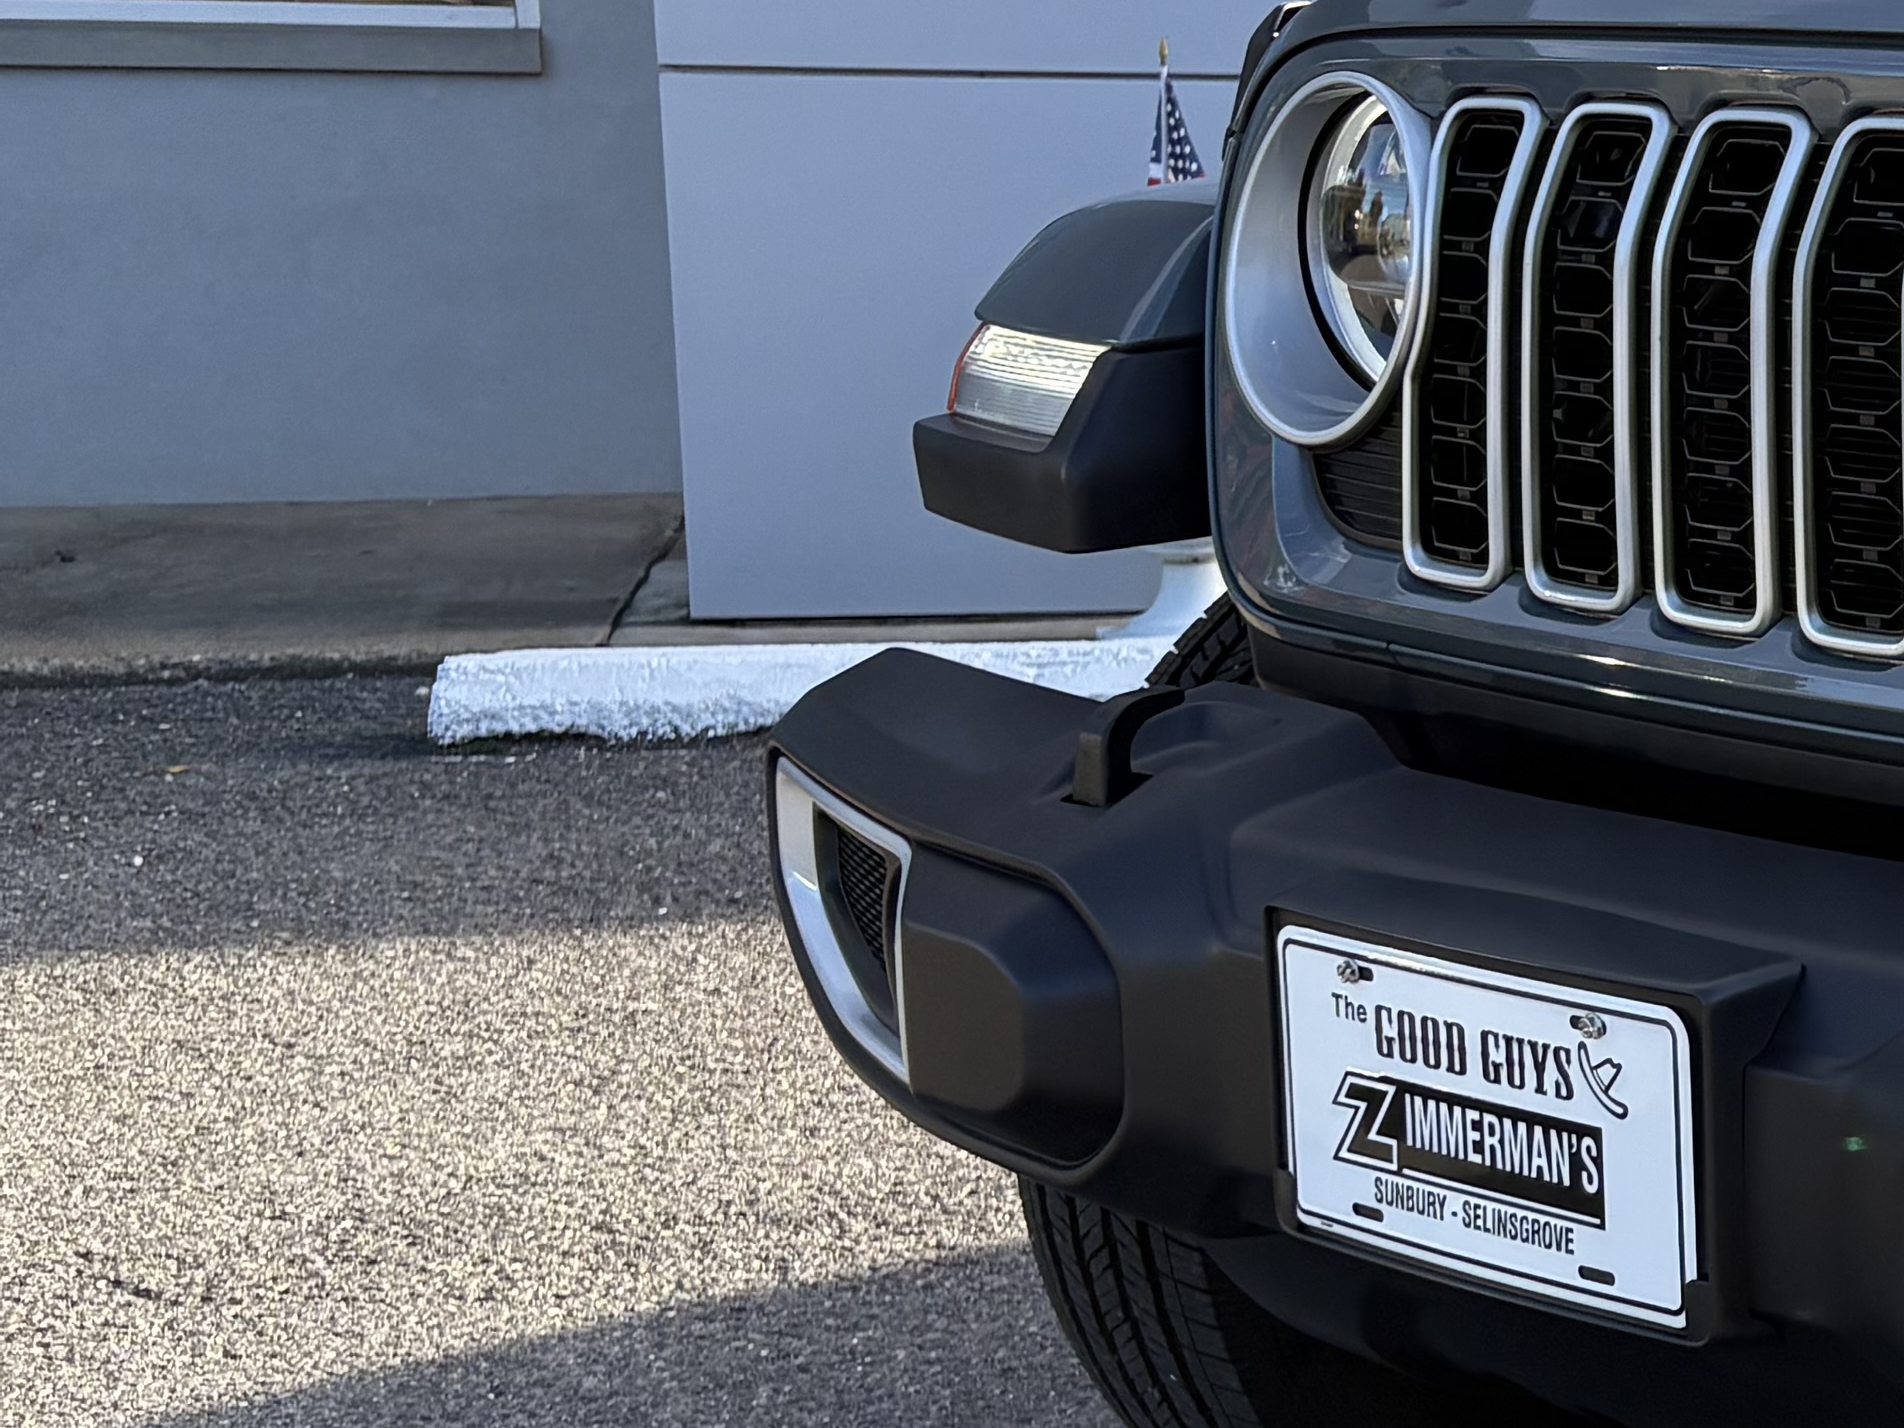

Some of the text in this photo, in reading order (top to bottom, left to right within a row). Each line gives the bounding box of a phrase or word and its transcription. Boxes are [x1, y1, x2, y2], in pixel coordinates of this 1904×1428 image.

[1332, 992, 1575, 1101] The GOOD GUYS
[1332, 1066, 1600, 1196] ZIMMERMAN'S
[1374, 1176, 1447, 1222] SUNBURY
[1461, 1199, 1575, 1255] SELINSGROVE
